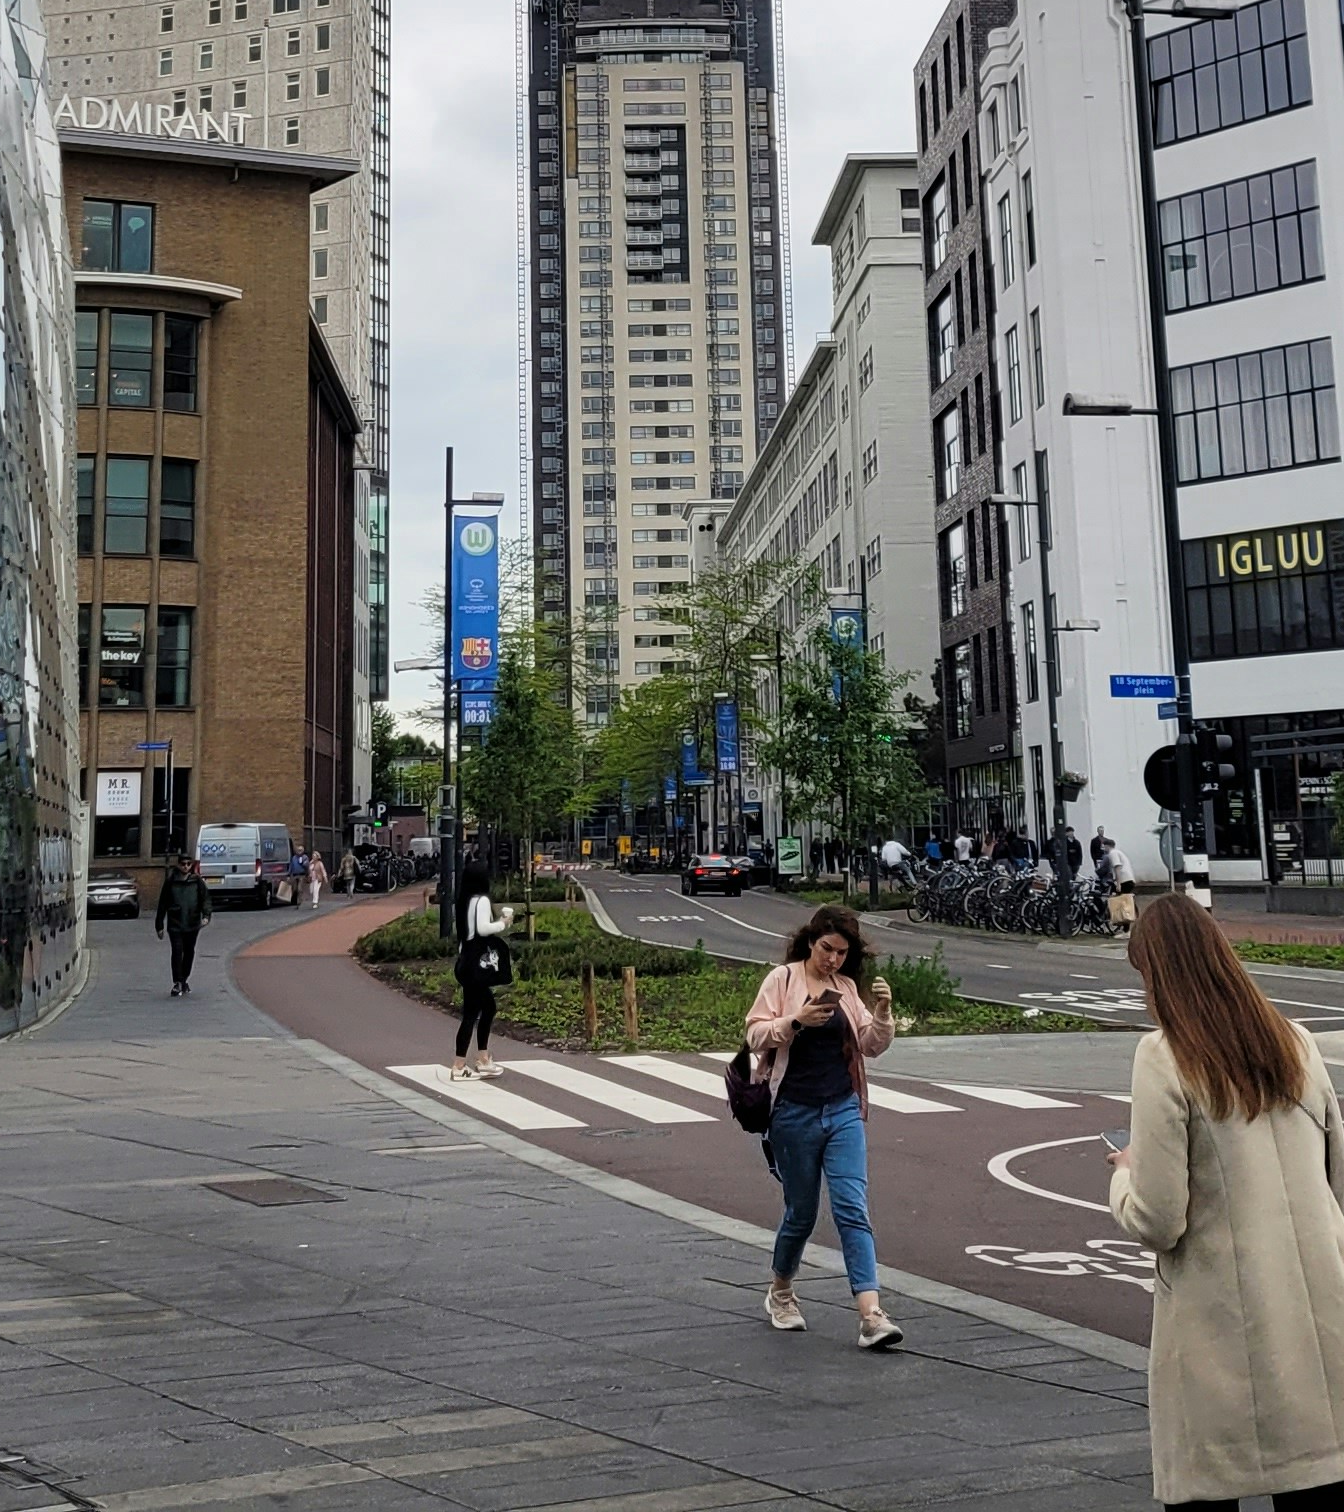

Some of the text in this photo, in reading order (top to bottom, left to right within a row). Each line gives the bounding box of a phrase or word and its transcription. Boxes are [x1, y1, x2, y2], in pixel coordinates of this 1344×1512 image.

[54, 92, 253, 144] ADMIRANT
[1216, 529, 1325, 577] IGLUU
[1115, 676, 1125, 685] 18
[1134, 686, 1154, 695] plein
[377, 804, 387, 819] P
